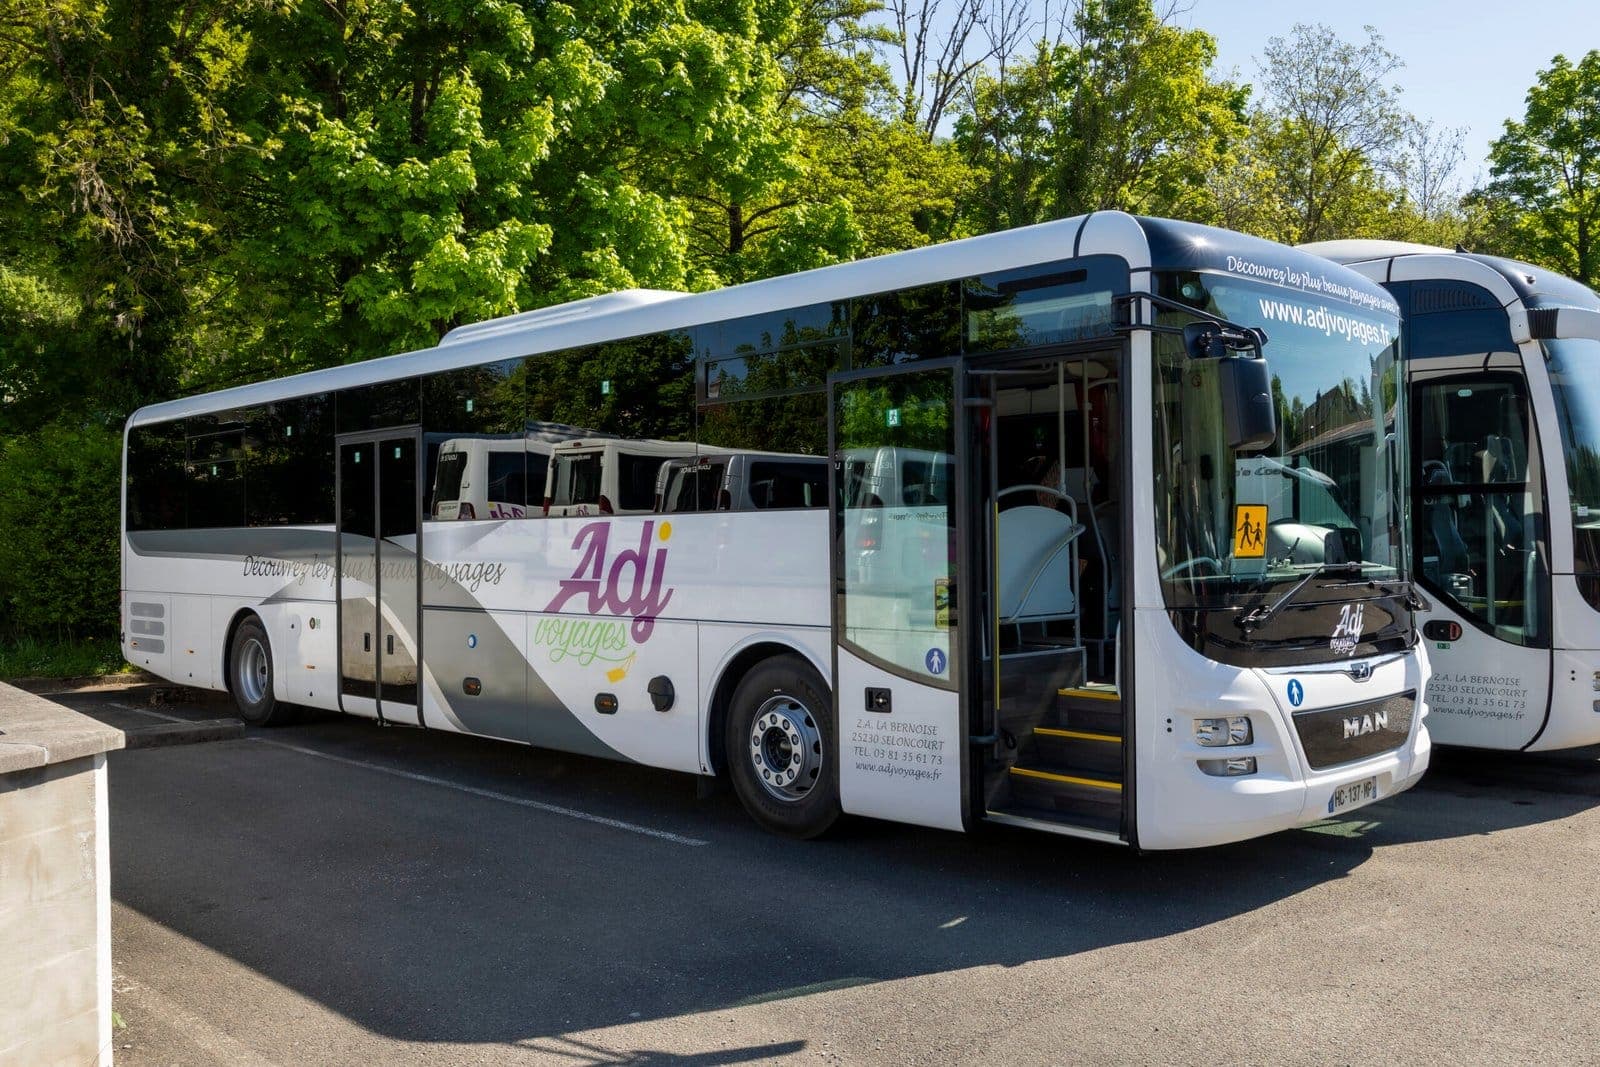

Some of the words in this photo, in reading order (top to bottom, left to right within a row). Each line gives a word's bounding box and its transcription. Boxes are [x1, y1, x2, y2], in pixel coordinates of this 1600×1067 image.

[1226, 255, 1287, 287] Découvrez
[1286, 266, 1301, 286] les
[1301, 271, 1322, 291] plus
[1321, 275, 1349, 298] beaux
[1349, 287, 1381, 311] paysages
[1259, 298, 1391, 346] www.adjvoyages.fr
[243, 553, 309, 586] Découvrez
[311, 553, 330, 580] les
[543, 520, 674, 644] Adj
[1332, 604, 1364, 643] Adj
[534, 618, 632, 667] voyages
[1455, 674, 1467, 683] LA
[1470, 675, 1520, 686] BERNOISE
[1429, 684, 1458, 692] 25230
[1460, 685, 1528, 698] SELONCOURT
[1452, 696, 1465, 704] 03
[1467, 697, 1479, 706] 81
[1483, 698, 1495, 707] 35
[1497, 700, 1509, 708] 61
[1513, 700, 1526, 709] 73
[1432, 706, 1525, 720] www.adjvoyages.fr
[856, 718, 874, 730] Z.A.
[876, 719, 887, 730] LA
[890, 721, 938, 736] BERNOISE
[1342, 710, 1388, 739] MAN
[852, 732, 879, 744] 25230
[880, 735, 945, 751] SELONCOURT
[873, 748, 885, 759] 03
[888, 750, 898, 760] 81
[902, 751, 913, 762] 35
[916, 753, 927, 764] 61
[931, 754, 943, 766] 73
[855, 761, 942, 781] www.adjvoyages.fr
